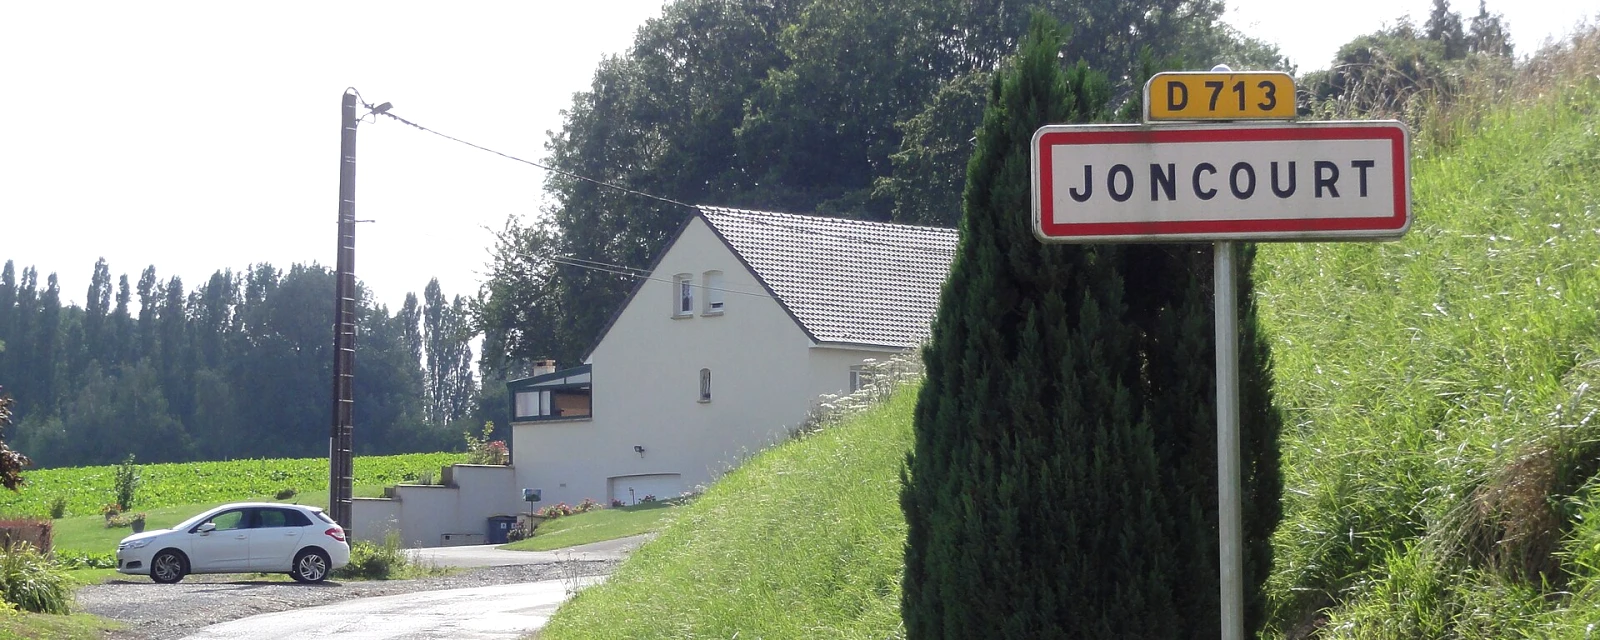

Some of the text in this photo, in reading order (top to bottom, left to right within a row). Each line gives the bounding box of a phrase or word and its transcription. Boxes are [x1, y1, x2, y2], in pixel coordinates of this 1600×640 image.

[1167, 81, 1277, 111] D 713
[1069, 160, 1375, 203] JONCOURT
